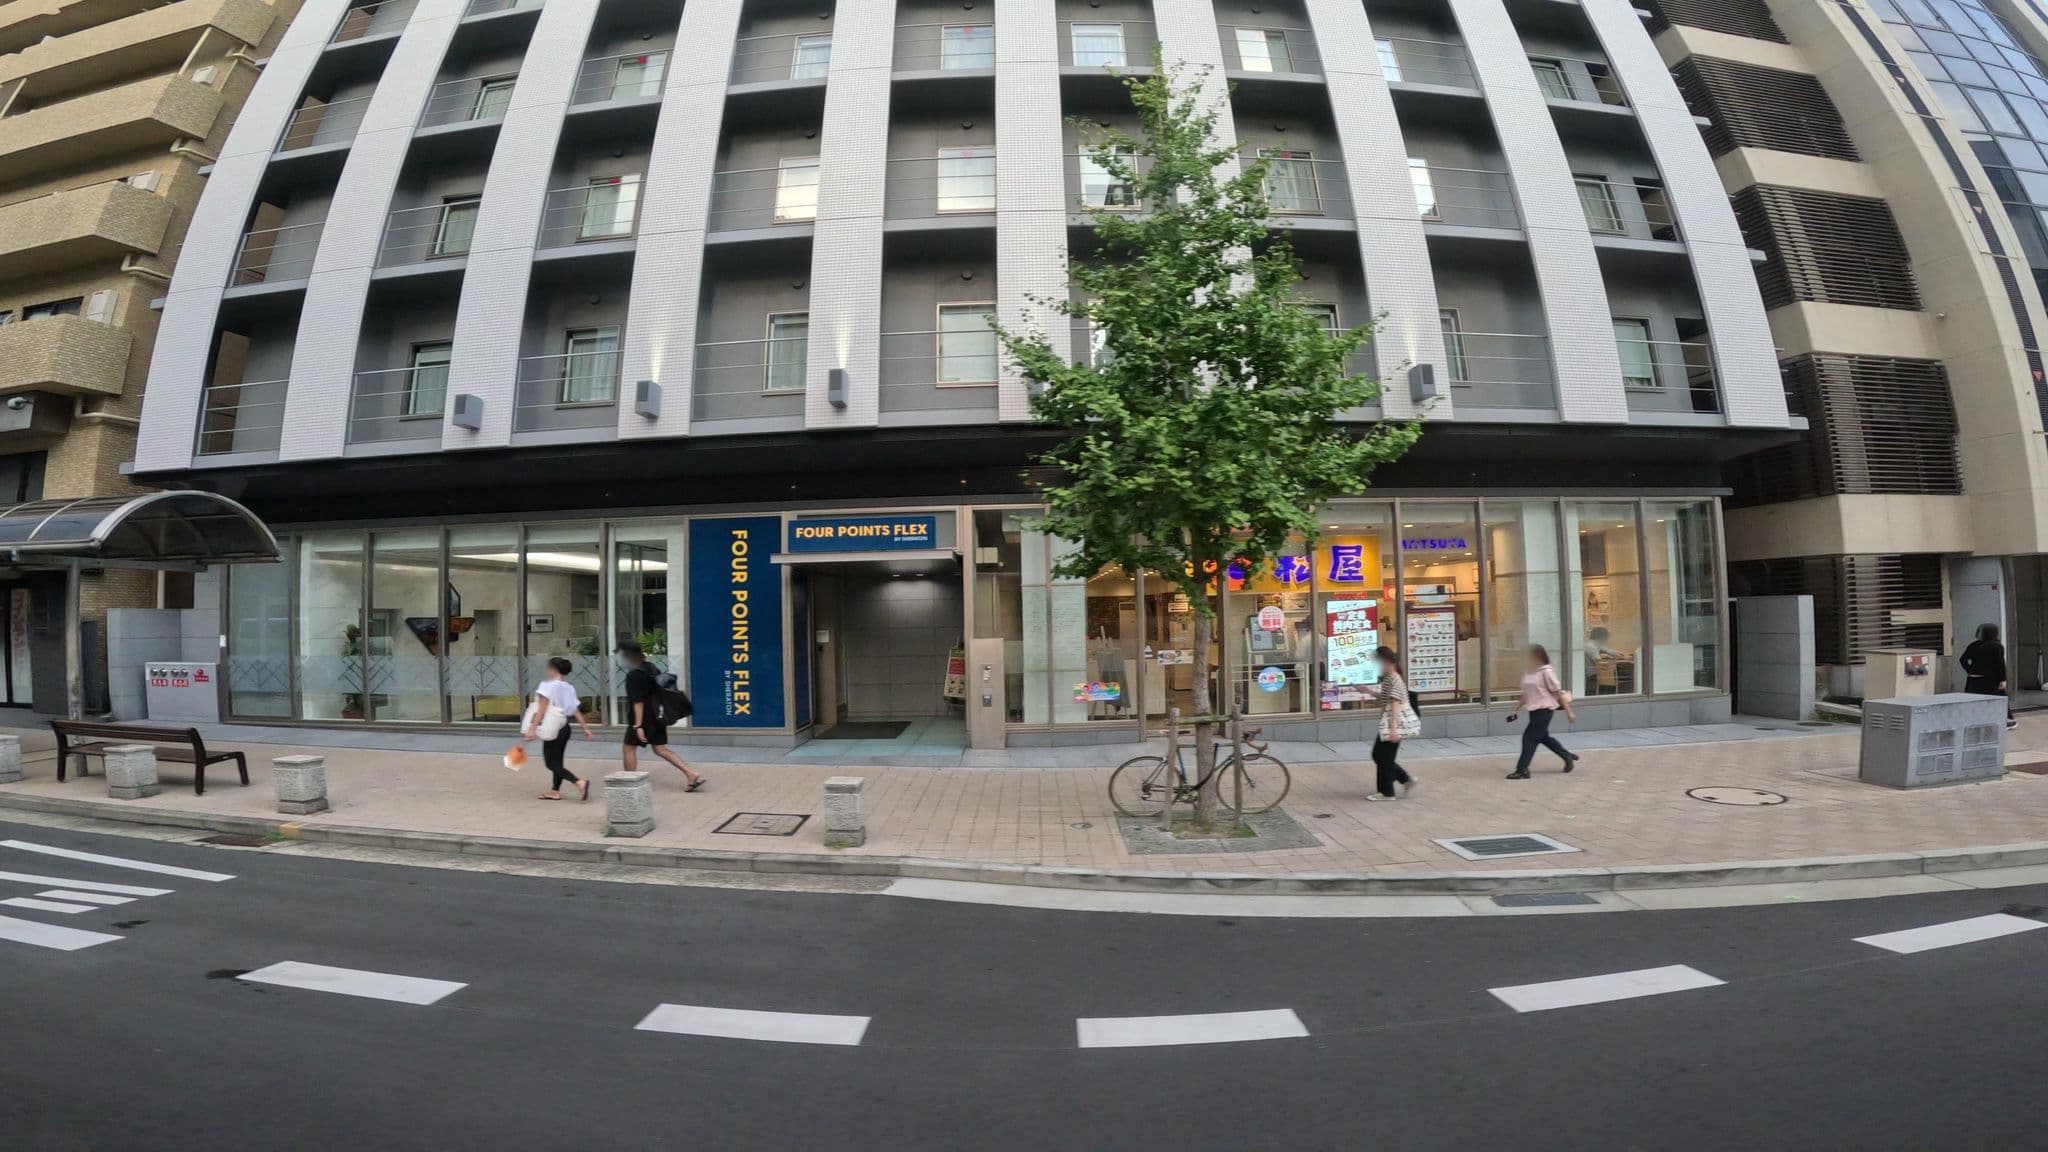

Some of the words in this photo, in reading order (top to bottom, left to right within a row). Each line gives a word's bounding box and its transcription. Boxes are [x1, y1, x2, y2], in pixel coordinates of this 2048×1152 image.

[796, 527, 834, 538] FOUR
[838, 525, 890, 537] POINTS
[894, 524, 927, 535] FLEX
[731, 530, 748, 583] FOUR
[732, 590, 749, 663] POINTS
[724, 670, 731, 678] BY
[733, 670, 750, 715] FLEX
